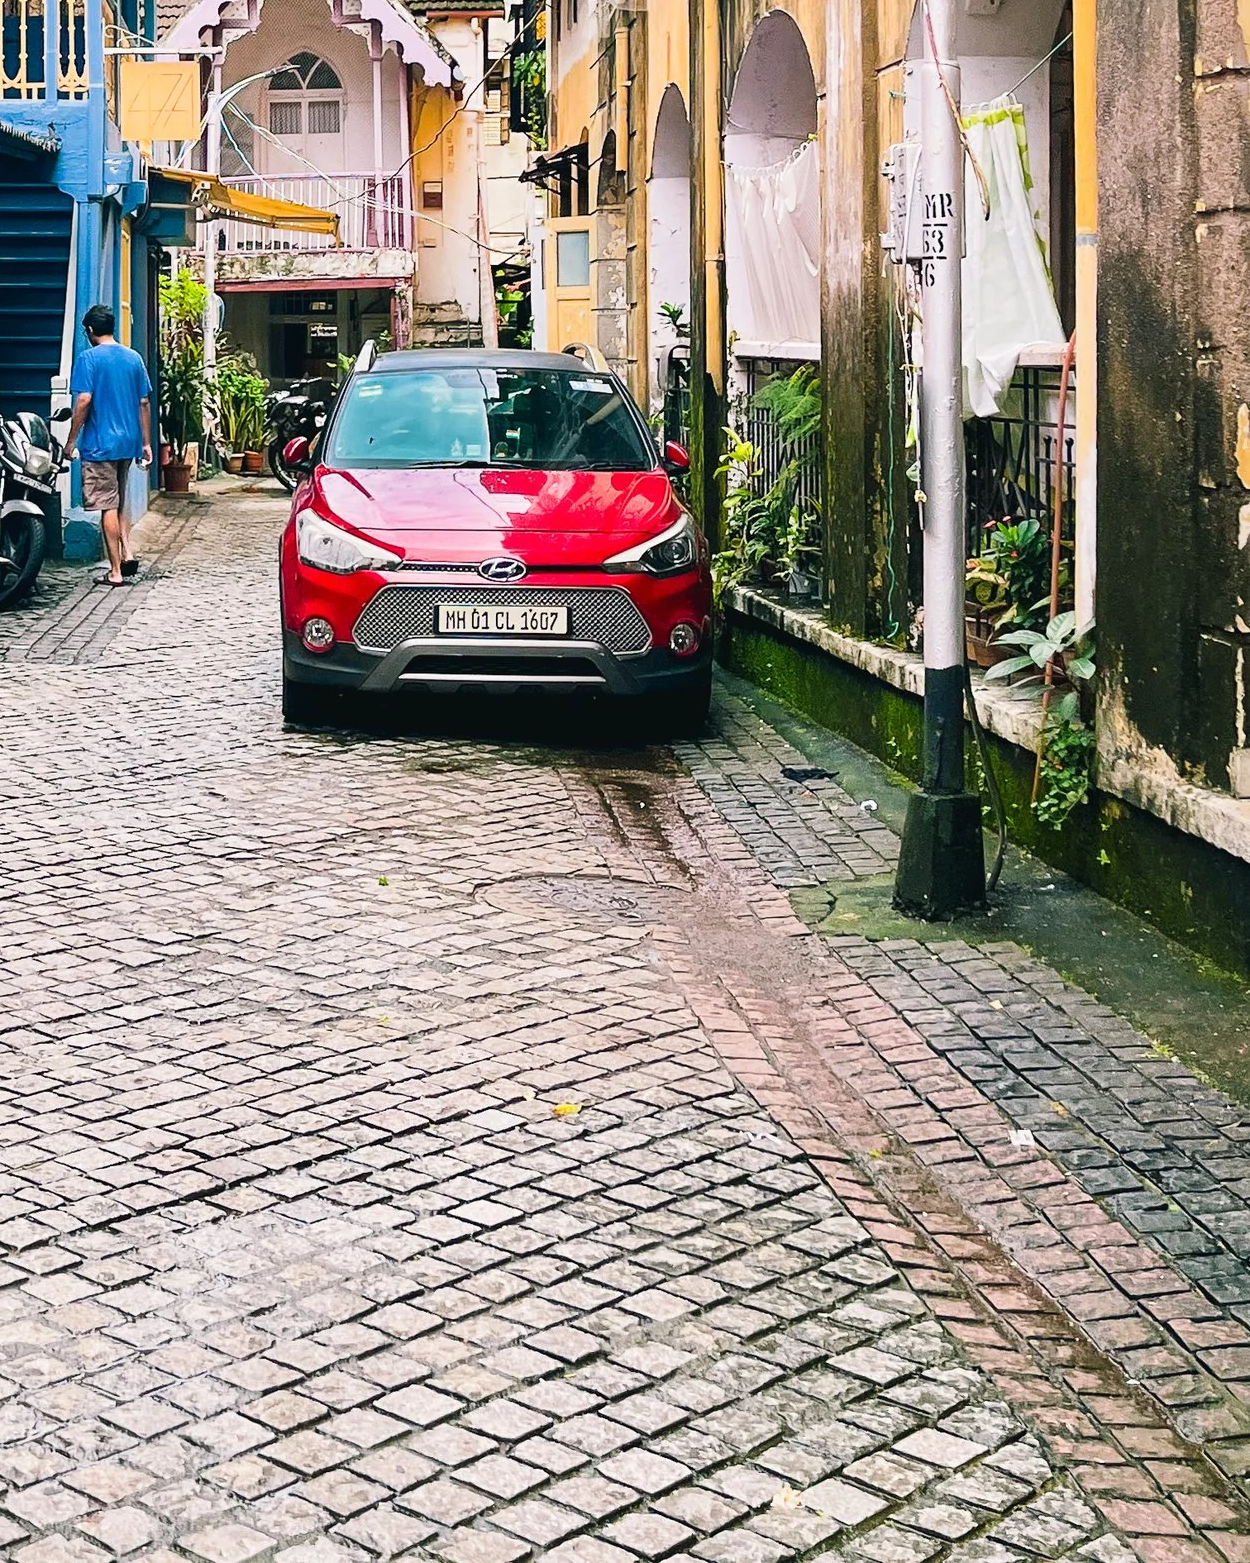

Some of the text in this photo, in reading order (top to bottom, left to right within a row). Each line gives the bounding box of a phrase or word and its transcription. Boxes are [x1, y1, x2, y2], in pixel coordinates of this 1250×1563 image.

[925, 193, 953, 219] MR
[925, 263, 935, 287] 6
[446, 610, 559, 631] MH 01 CL 1607
